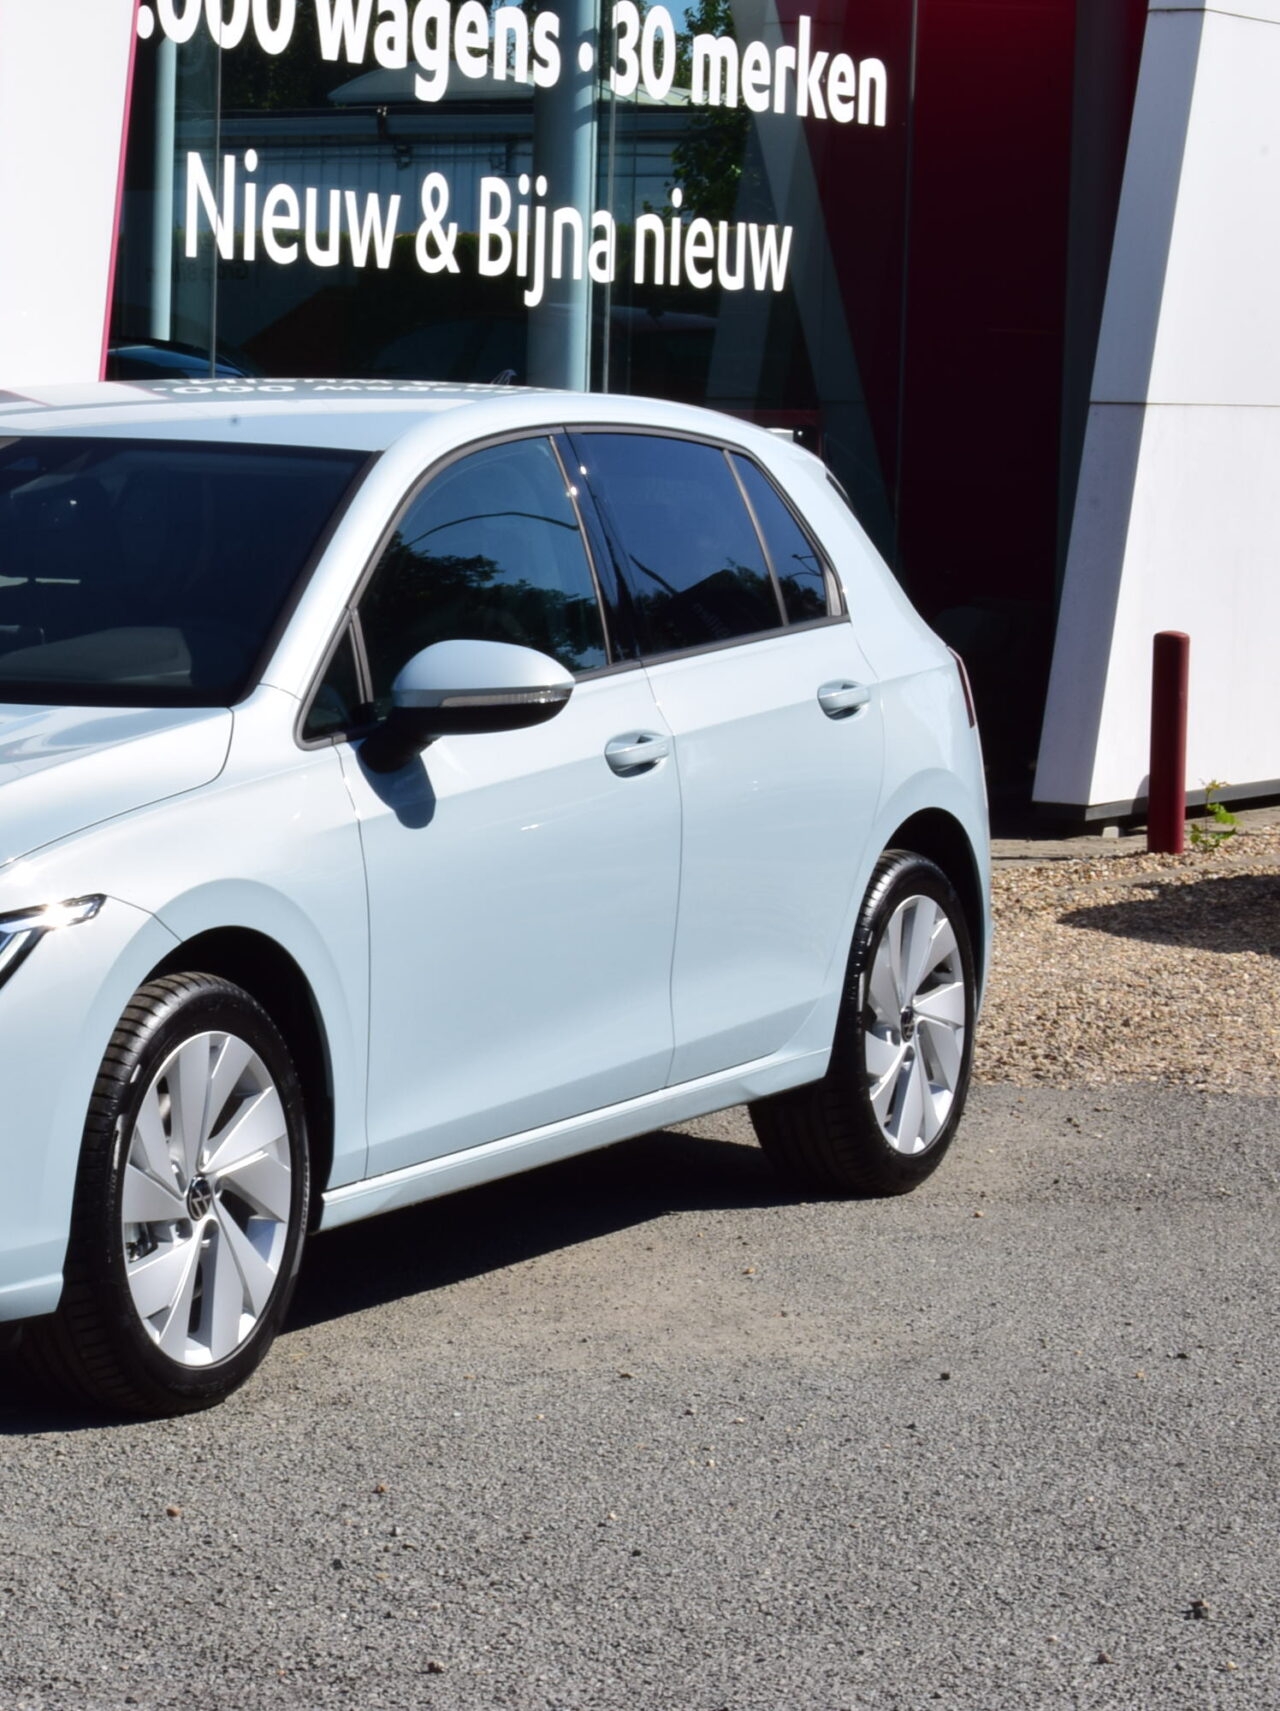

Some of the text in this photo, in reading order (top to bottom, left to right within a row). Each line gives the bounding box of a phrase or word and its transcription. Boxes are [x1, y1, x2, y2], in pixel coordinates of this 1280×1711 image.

[315, 0, 561, 102] wagens
[609, 0, 677, 101] 30
[690, 15, 887, 127] merken
[185, 149, 793, 307] Nieuw & Bijna nieuw
